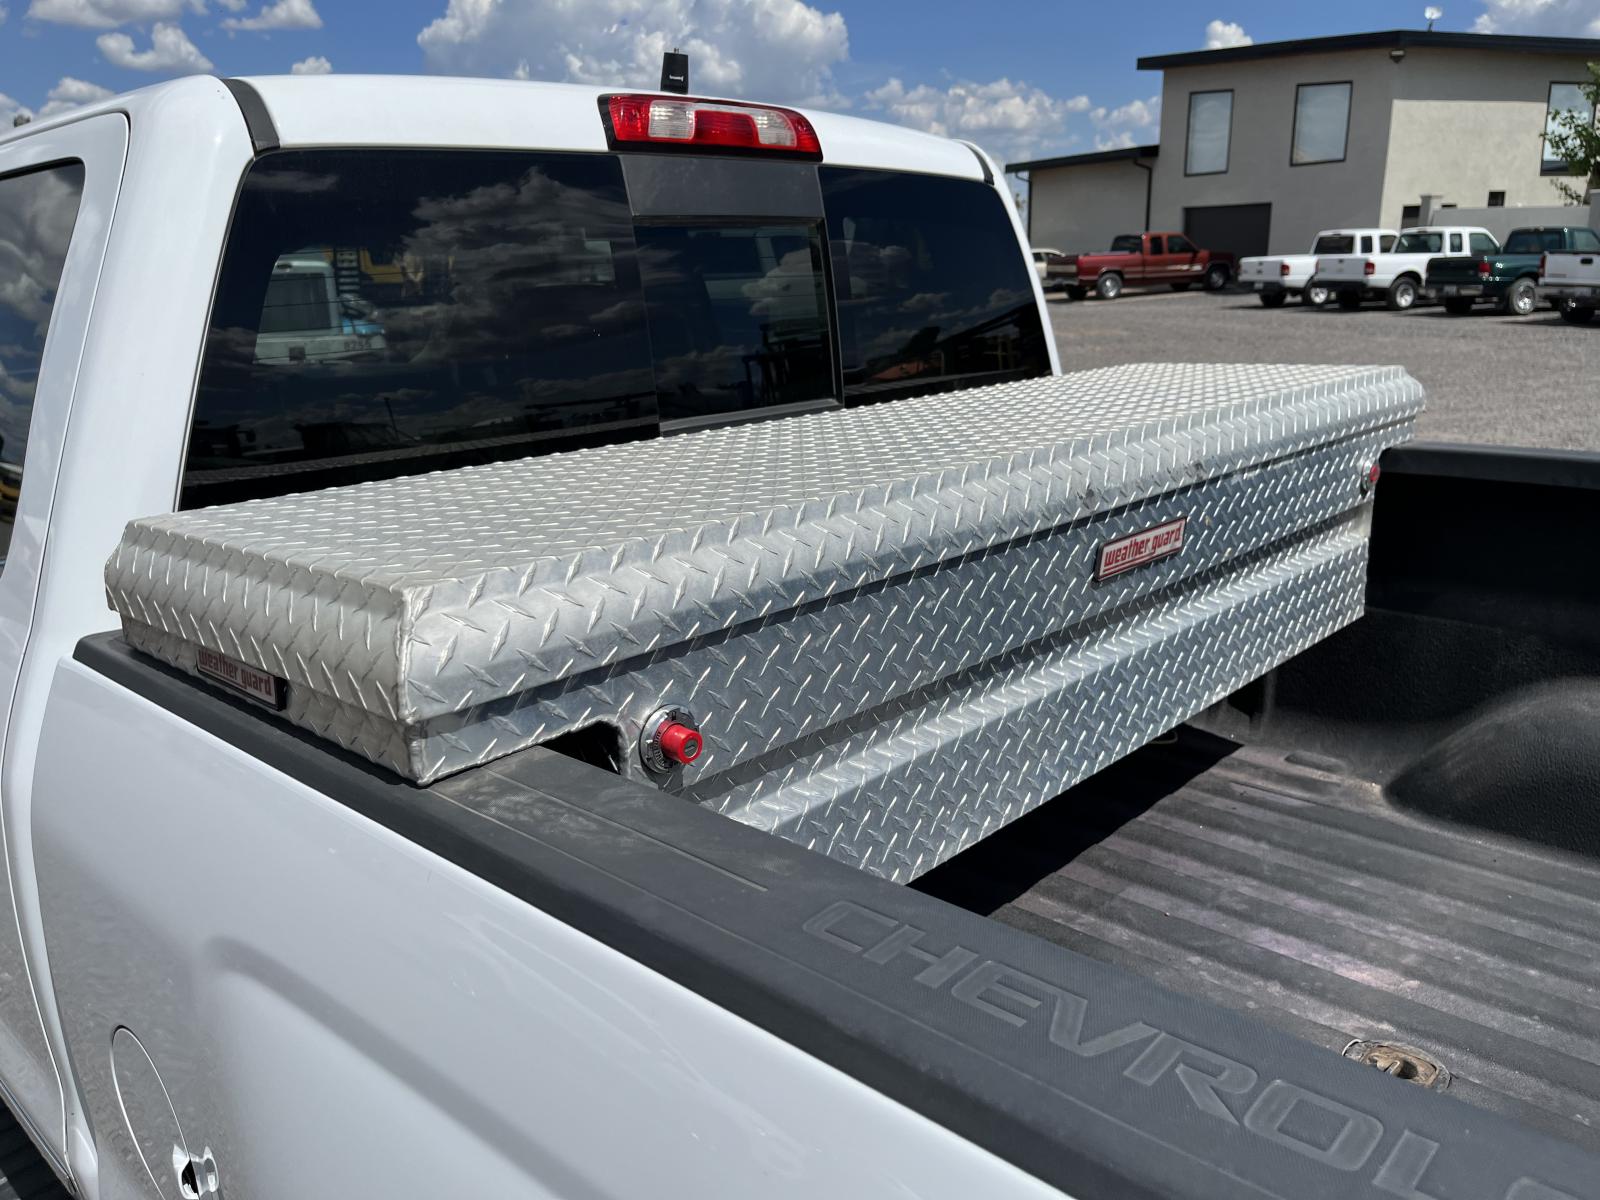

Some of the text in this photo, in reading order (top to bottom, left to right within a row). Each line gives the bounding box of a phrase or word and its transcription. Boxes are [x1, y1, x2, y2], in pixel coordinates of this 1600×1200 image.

[1103, 523, 1182, 567] weather guard
[198, 649, 272, 696] weather guard
[801, 899, 1582, 1200] CHEVROL
